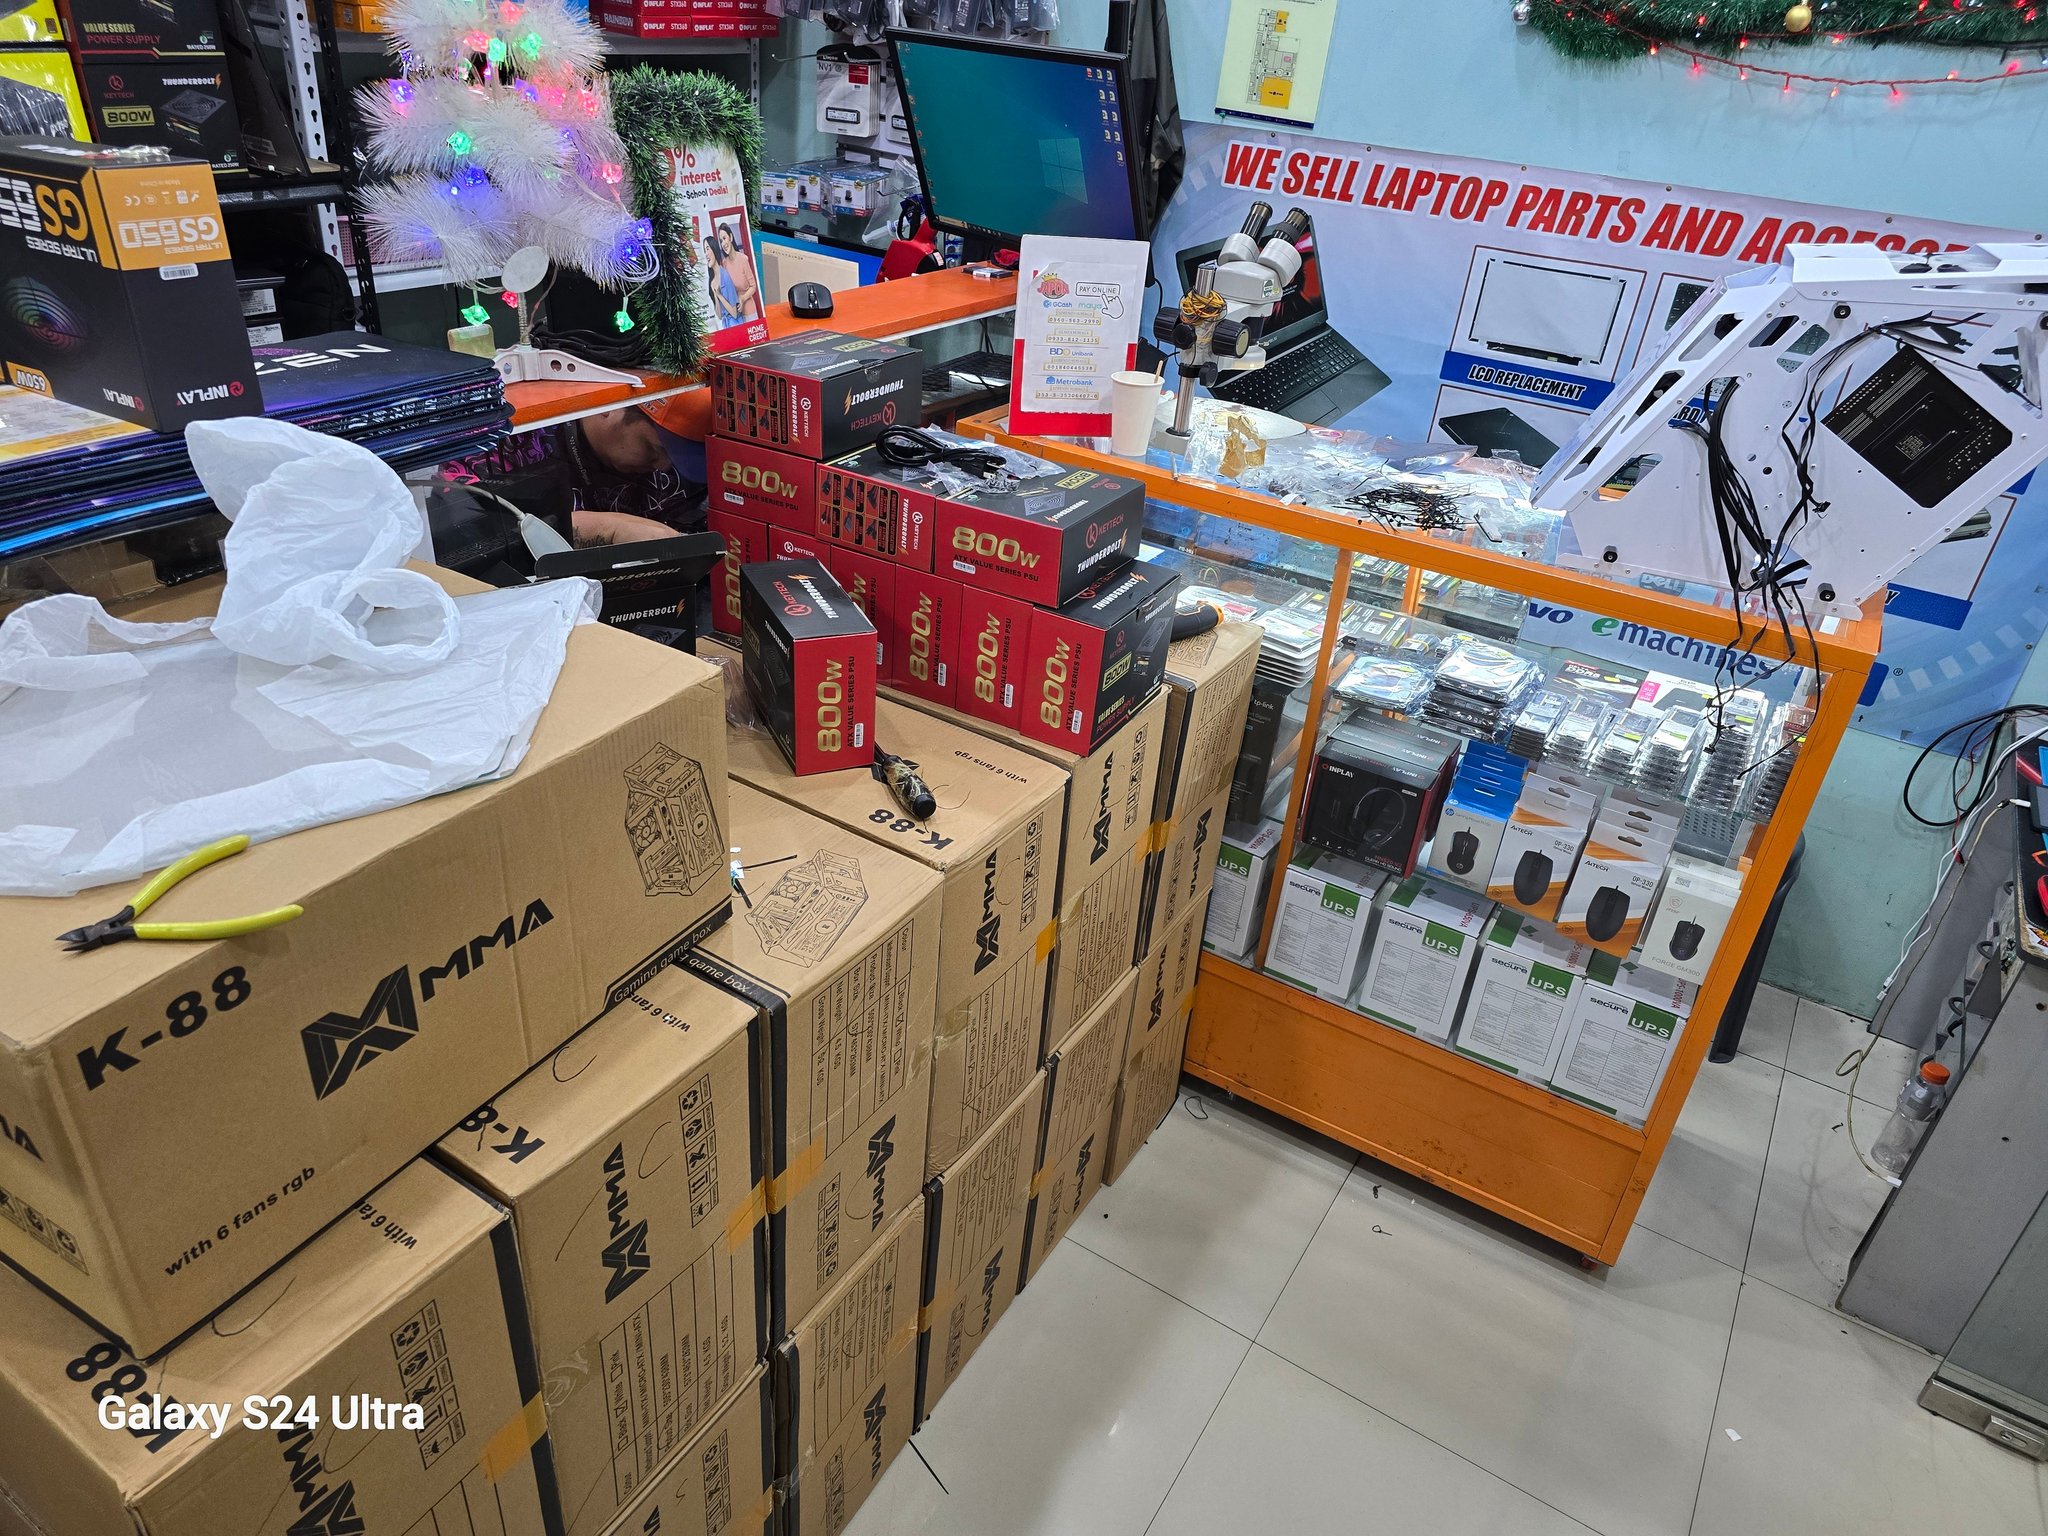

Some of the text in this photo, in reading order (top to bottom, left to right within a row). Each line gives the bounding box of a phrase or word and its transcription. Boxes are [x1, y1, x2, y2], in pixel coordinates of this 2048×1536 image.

[83, 23, 136, 33] VALUE SERIES
[86, 34, 161, 44] POWER SUPPLY
[162, 77, 216, 86] THUNDERBOLT
[107, 110, 152, 122] 800W
[680, 168, 722, 186] interest
[708, 186, 729, 197] Deals!
[1224, 144, 1282, 190] WE
[1283, 152, 1360, 202] SELL
[1362, 163, 1507, 222] LAPTOP
[1506, 184, 1645, 245] PARTS
[1640, 204, 1744, 258] AND
[118, 216, 220, 249] GS650
[25, 235, 99, 263] ULTRA SERIES
[747, 323, 764, 335] HOME
[749, 330, 768, 343] CREDIT
[1049, 347, 1071, 356] BDO
[16, 369, 47, 392] 650W
[1056, 378, 1093, 386] Metrobank
[1469, 364, 1586, 400] LCD REPLACEMENT
[851, 379, 905, 406] THUNDERBOLT
[790, 384, 799, 438] THUNDERBOLT
[850, 412, 882, 431] KEYTECH
[738, 490, 759, 501] VALUE
[760, 494, 785, 508] SERIES
[785, 500, 799, 511] PSU
[900, 498, 909, 550] THUNDERBOLT
[1099, 514, 1125, 535] KEYTECH
[794, 546, 815, 557] KEYTECH
[1077, 538, 1122, 574] THUNDERBOLT
[969, 557, 994, 571] VALUE
[995, 564, 1022, 577] SERIES
[1023, 573, 1040, 582] PSU
[772, 581, 796, 604] KEYTECH
[1092, 576, 1140, 610] THUNDERBOLT
[1641, 573, 1683, 594] DELL
[799, 579, 840, 619] THUNDERBOLT
[610, 604, 677, 624] THUNDERBOLT
[1071, 661, 1080, 691] SERIES
[1254, 699, 1274, 711] tp-link
[847, 710, 855, 733] VALUE
[953, 749, 972, 764] rgb
[973, 755, 995, 775] fans
[1006, 768, 1029, 784] with
[868, 808, 954, 851] K-88
[1219, 857, 1248, 877] UPS
[1289, 880, 1322, 896] secure
[1323, 899, 1354, 917] UPS
[1388, 917, 1423, 935] secure
[1424, 936, 1459, 956] UPS
[614, 923, 713, 1003] Gaming game box
[868, 953, 878, 983] Product
[1491, 957, 1528, 975] secure
[1651, 956, 1701, 977] FORGE GM300
[690, 958, 751, 993] game box
[1530, 976, 1568, 997] UPS
[833, 995, 844, 1023] Weight
[1590, 996, 1629, 1016] secure
[75, 966, 254, 1092] K-88
[651, 1006, 691, 1031] with 6
[815, 995, 826, 1045] Gross Weight
[1630, 1017, 1671, 1039] UPS
[164, 1164, 317, 1277] with 6 fans rgb
[369, 1213, 419, 1250] with 6
